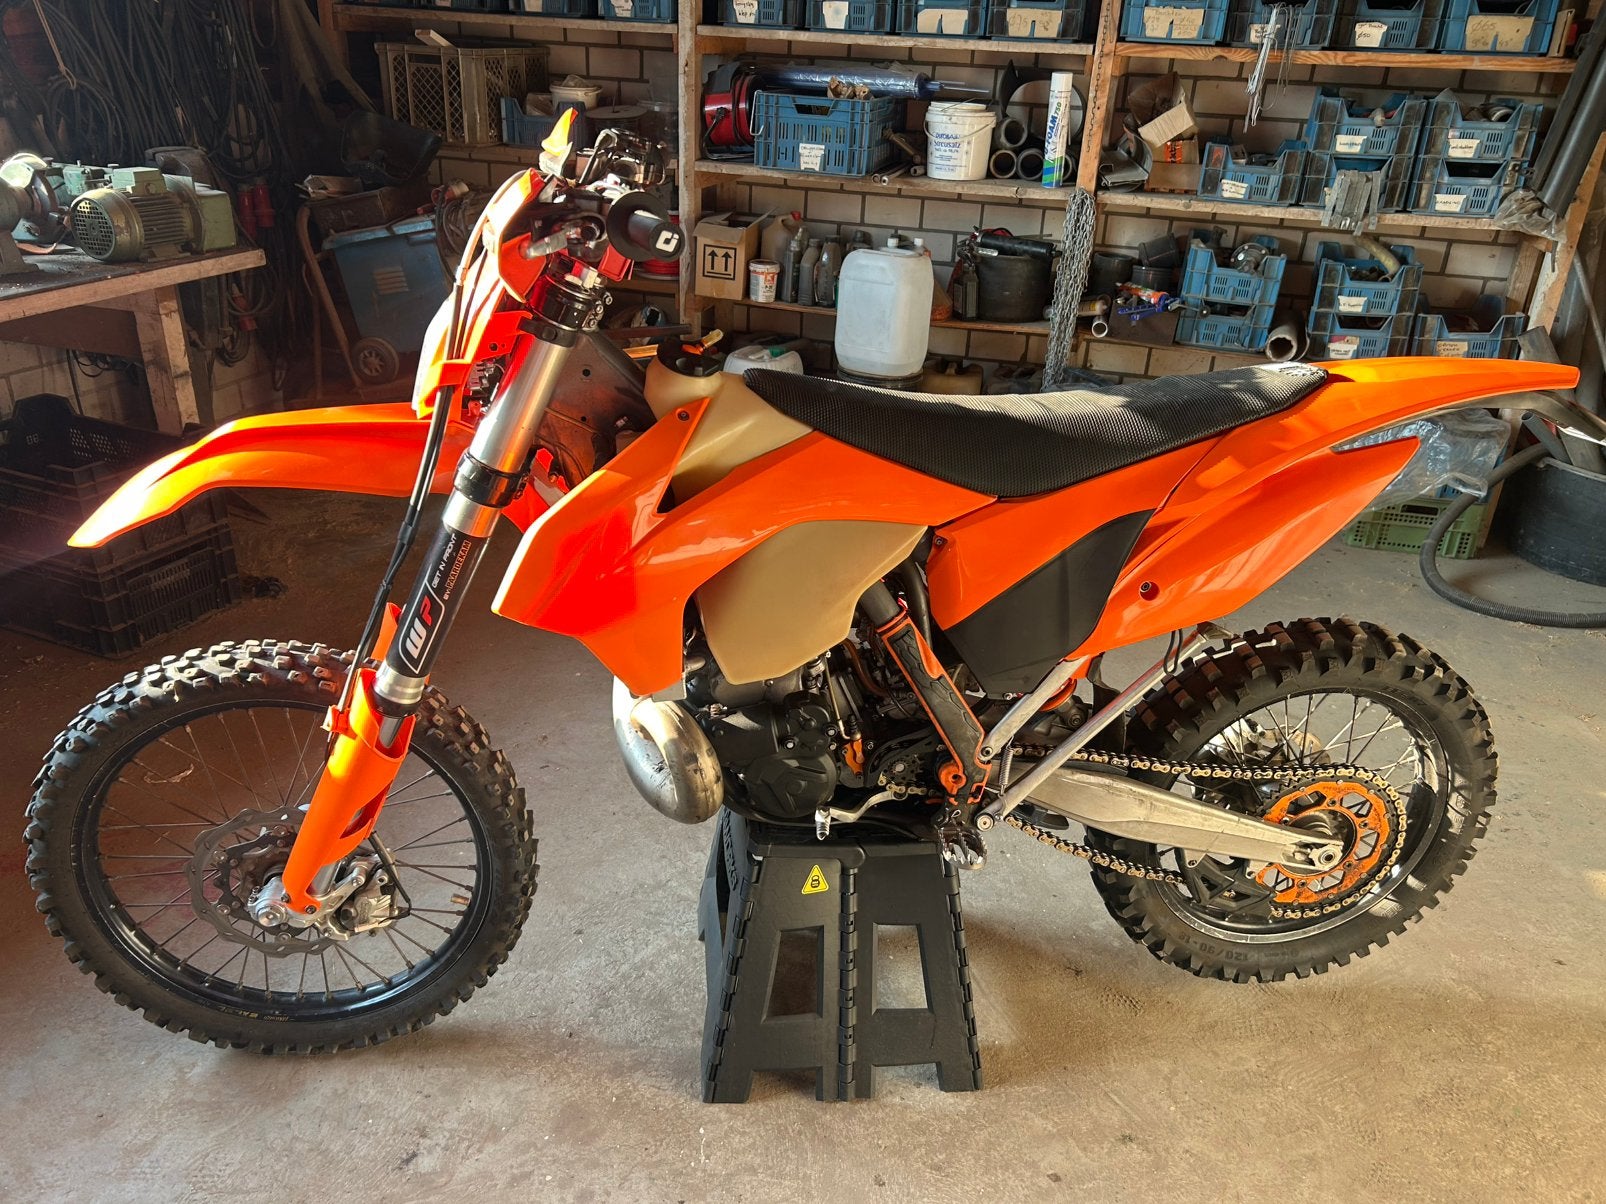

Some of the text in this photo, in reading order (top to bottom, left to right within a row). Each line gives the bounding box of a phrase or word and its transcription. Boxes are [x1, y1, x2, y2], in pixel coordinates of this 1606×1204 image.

[1054, 101, 1062, 114] 750
[431, 570, 442, 589] GET
[442, 533, 457, 562] FRONT
[445, 540, 472, 589] PAARDEKAM
